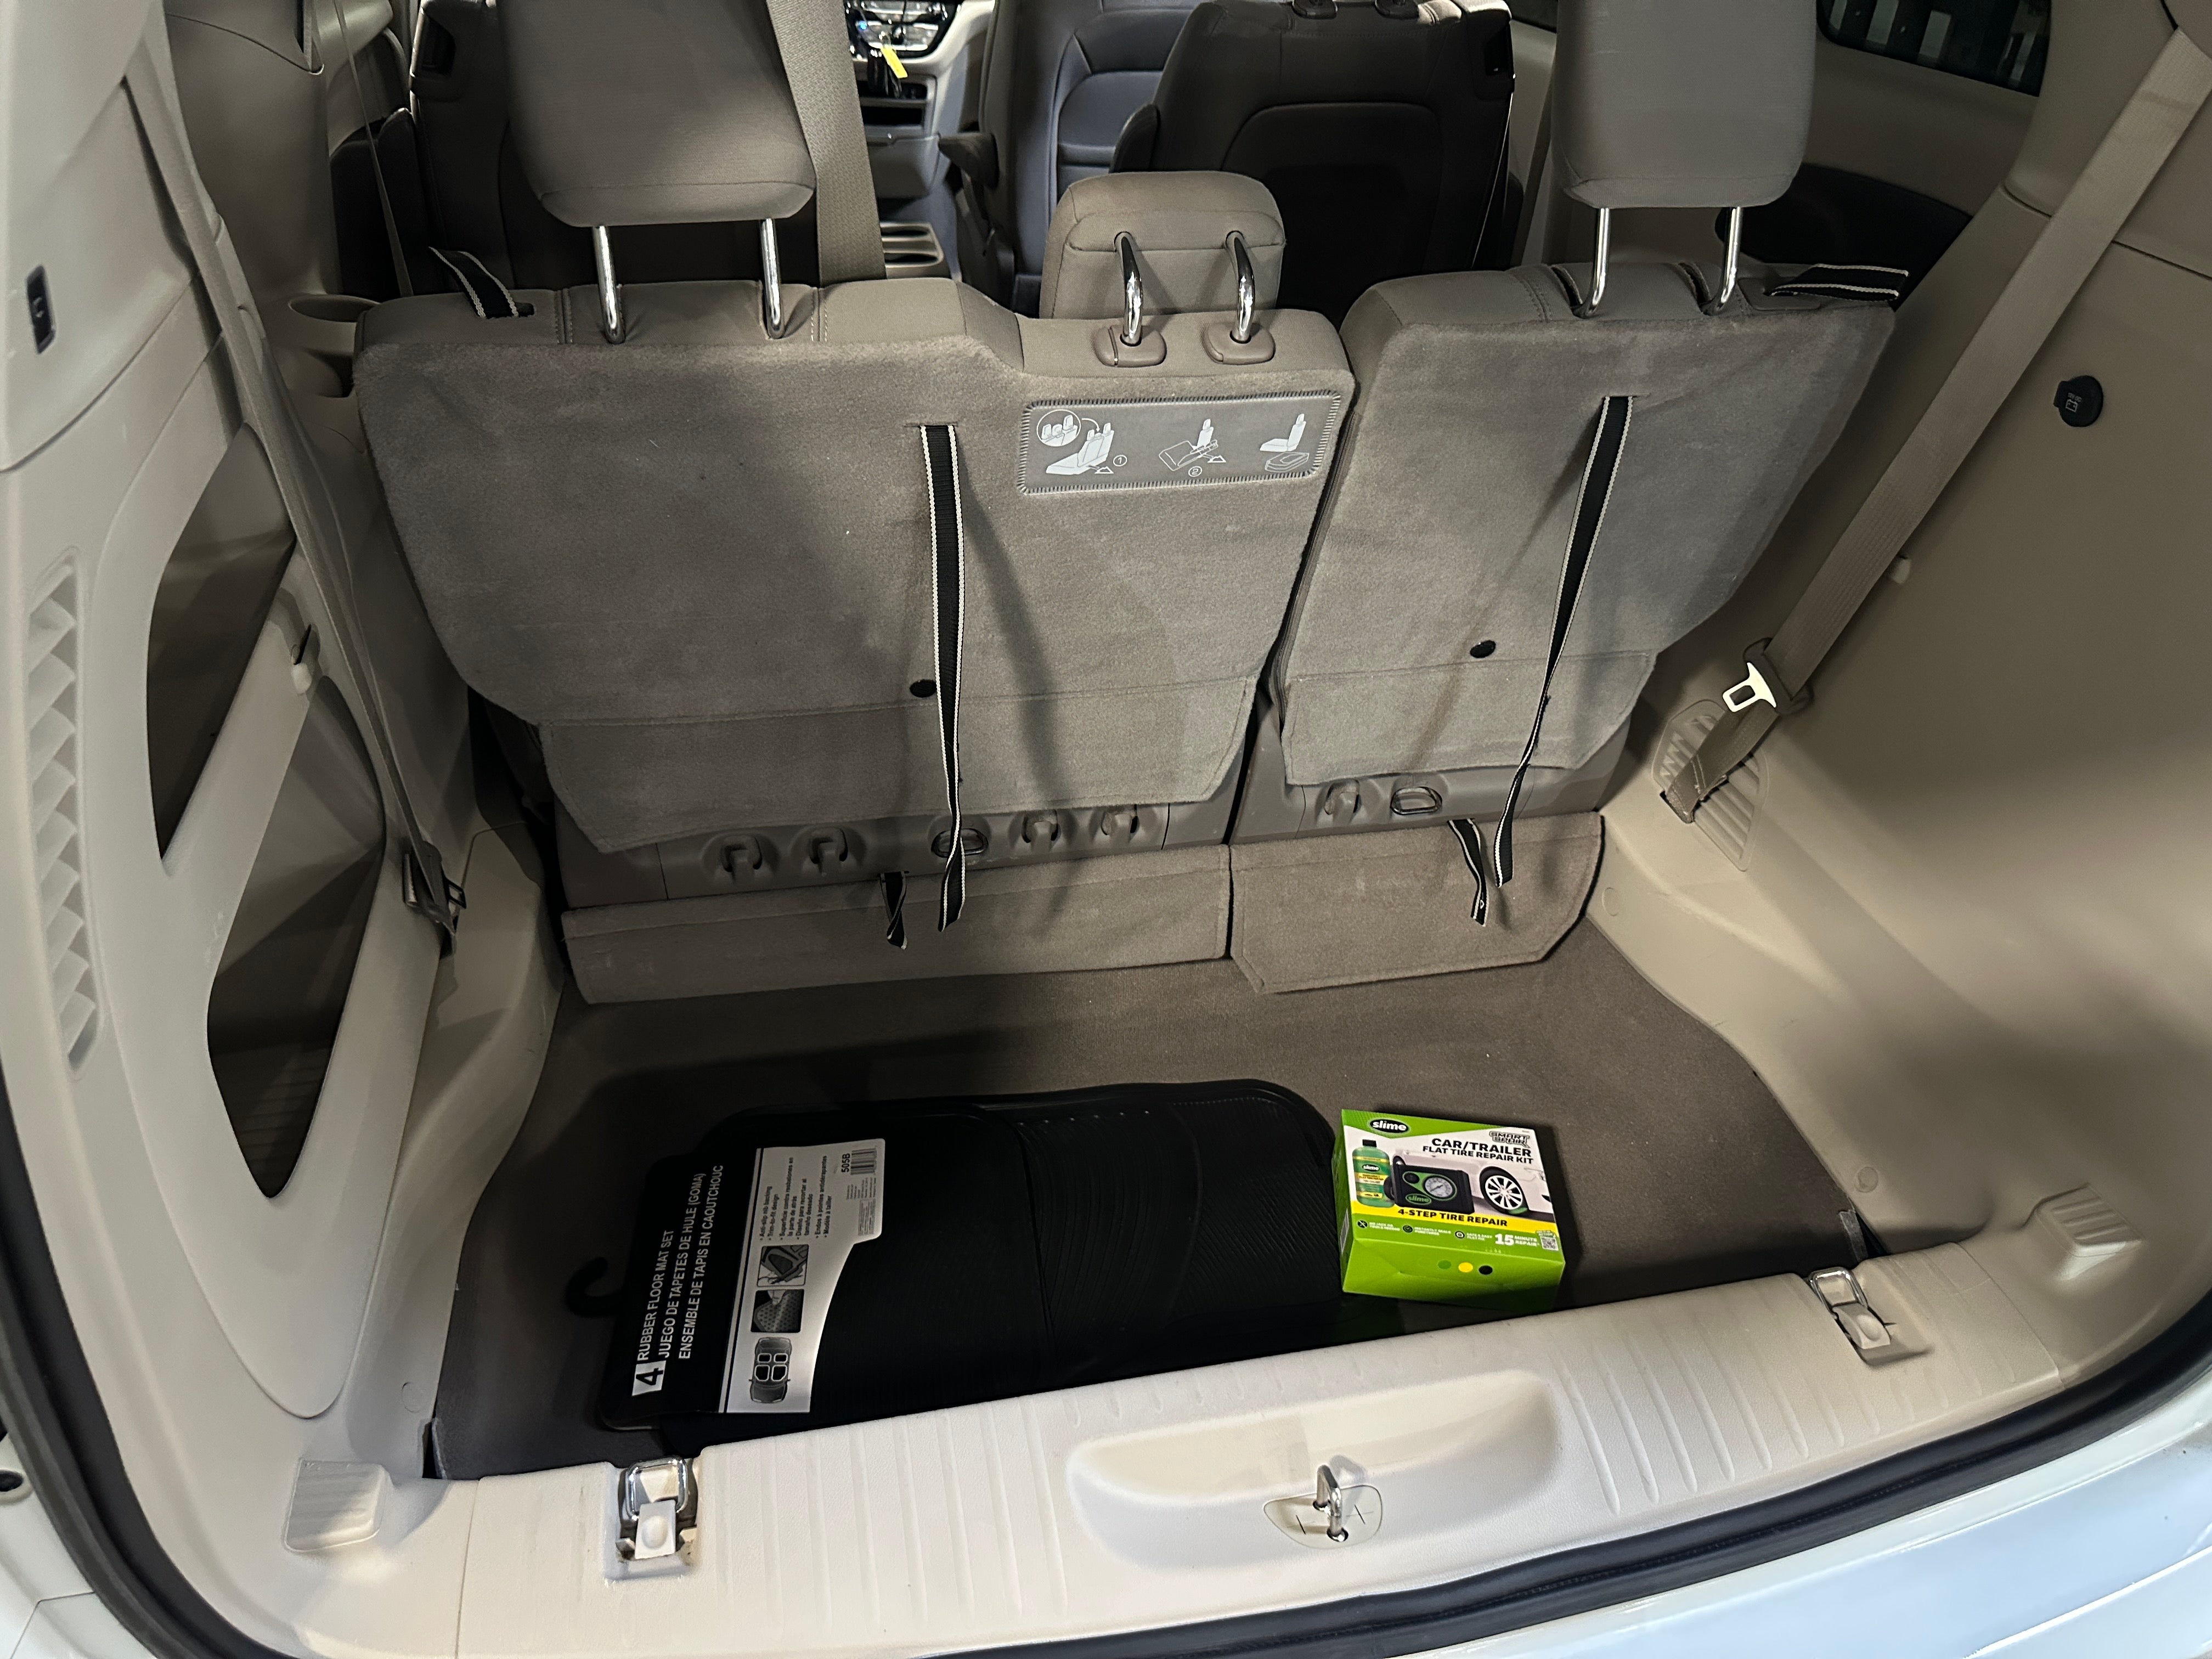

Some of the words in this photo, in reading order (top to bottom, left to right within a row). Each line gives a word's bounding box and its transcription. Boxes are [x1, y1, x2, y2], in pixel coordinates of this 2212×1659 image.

[1372, 1120, 1407, 1131] slime
[1432, 1138, 1532, 1156] CAR/TRAILER
[1476, 1152, 1514, 1161] REPAIR
[842, 1153, 850, 1173] 505B
[688, 1173, 707, 1205] (GOMA)
[702, 1165, 723, 1229] CAOUTCHOUC
[764, 1186, 772, 1205] backing
[771, 1194, 780, 1211] design
[682, 1207, 697, 1233] HULE
[1398, 1209, 1437, 1217] 4-STEP
[1440, 1213, 1464, 1221] TIRE
[1467, 1216, 1508, 1226] REPAIR
[661, 1230, 674, 1248] SET
[679, 1235, 691, 1250] DE
[699, 1232, 712, 1246] EN
[1495, 1233, 1514, 1245] 15
[655, 1251, 669, 1271] MAT
[693, 1249, 708, 1279] TAPIS
[669, 1252, 688, 1299] TAPETES
[647, 1273, 665, 1310] FLOOR
[690, 1281, 703, 1296] DE
[665, 1301, 679, 1315] DE
[637, 1311, 657, 1361] RUBBER
[658, 1318, 675, 1358] JUEGO
[679, 1298, 700, 1359] ENSEMBLE
[636, 1367, 663, 1386] 4
